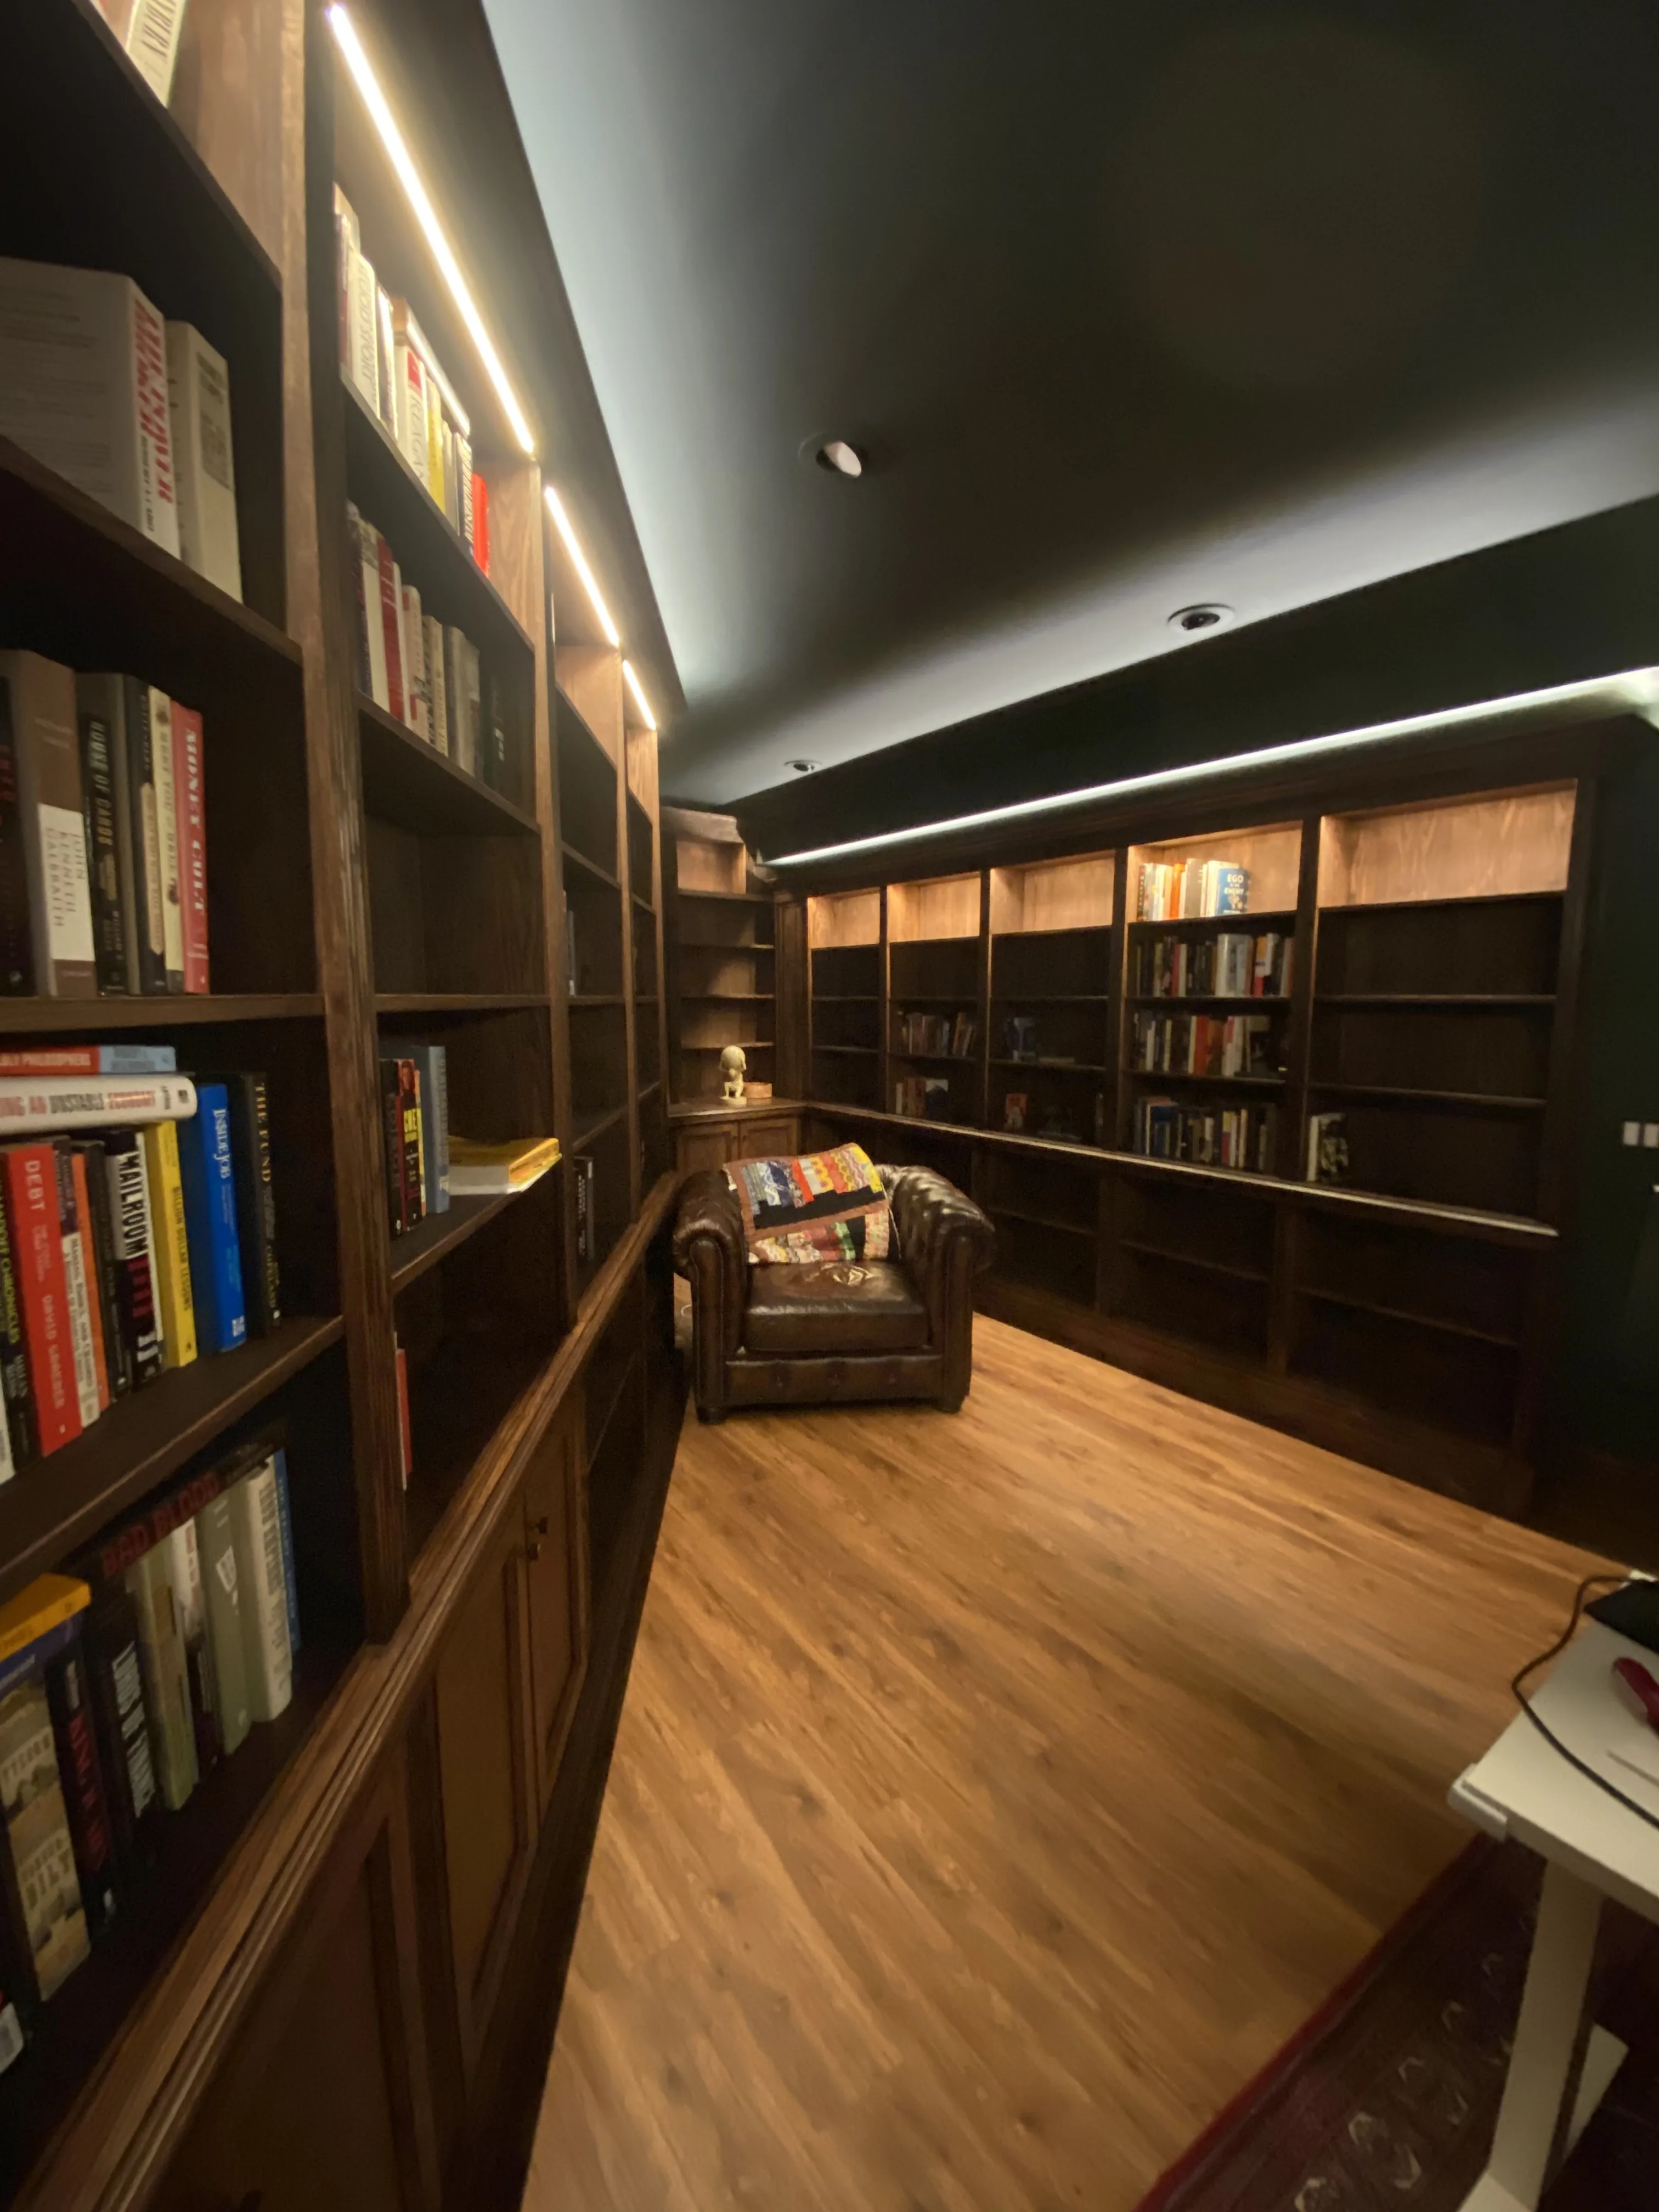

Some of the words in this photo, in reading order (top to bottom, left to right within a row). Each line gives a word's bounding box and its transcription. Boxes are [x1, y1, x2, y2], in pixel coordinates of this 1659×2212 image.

[89, 721, 111, 772] HOUSE
[94, 774, 111, 792] OF
[46, 827, 64, 927] GALBRAITH
[60, 832, 77, 913] KENNETH
[73, 833, 86, 880] JOHN
[190, 840, 206, 915] CULT
[1227, 874, 1244, 883] EGO
[255, 1085, 268, 1125] THE
[212, 1108, 230, 1155] INSIDE
[258, 1128, 272, 1183] FUND
[24, 1159, 46, 1211] DEBT
[212, 1153, 231, 1179] JOB
[119, 1150, 148, 1261] MAILROOM
[41, 1294, 59, 1341] DAVID
[102, 1523, 149, 1576] BAD
